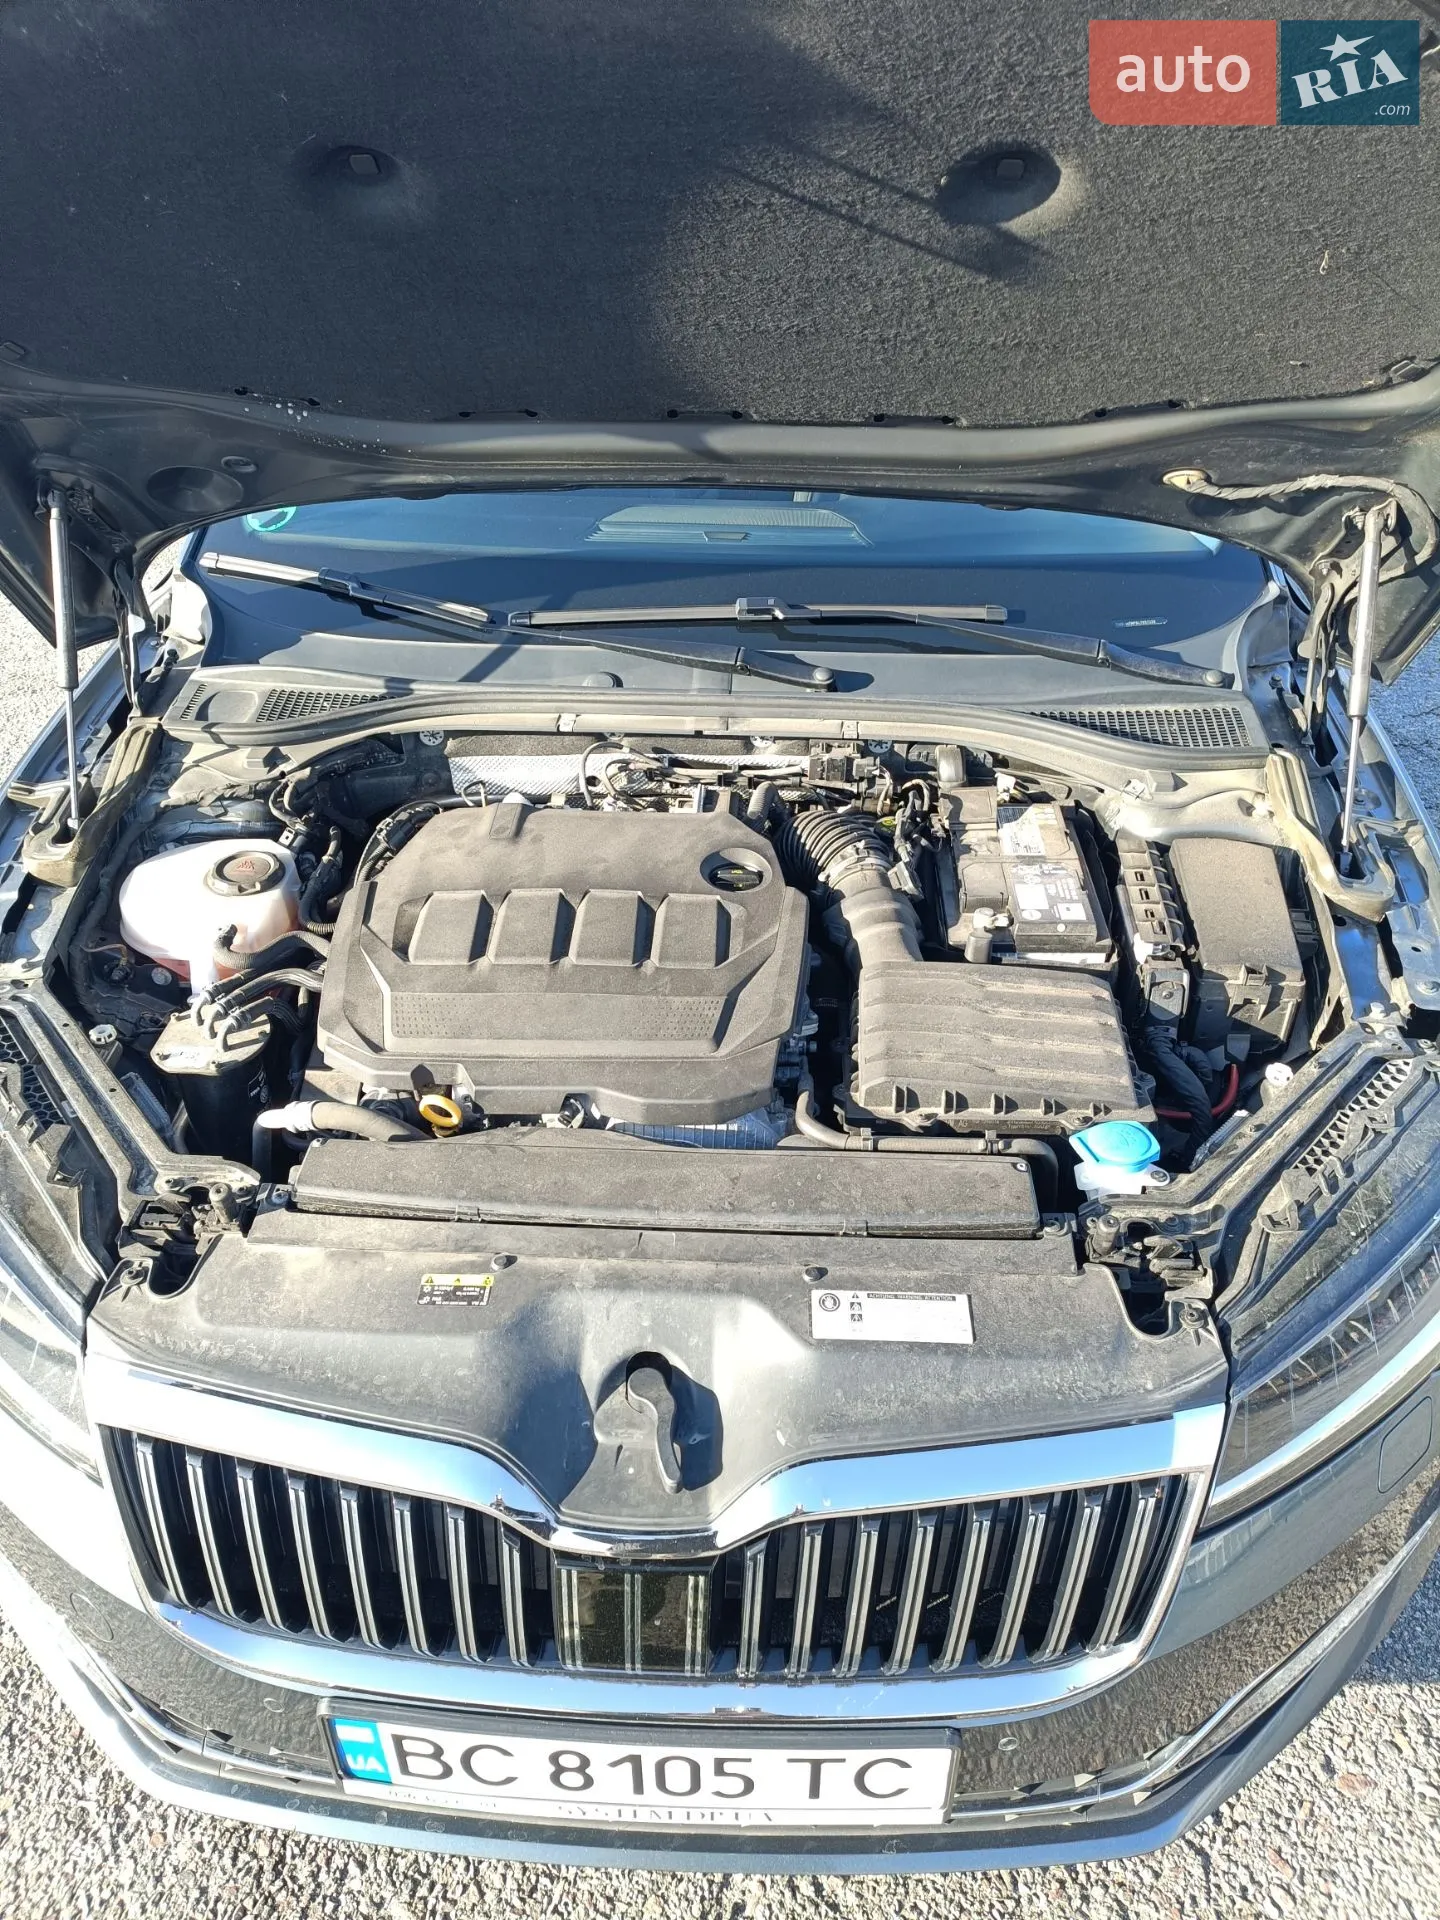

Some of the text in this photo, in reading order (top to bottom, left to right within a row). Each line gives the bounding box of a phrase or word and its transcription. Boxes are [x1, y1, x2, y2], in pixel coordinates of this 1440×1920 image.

[346, 1754, 384, 1773] UA
[391, 1734, 913, 1799] BC 8105 TC
